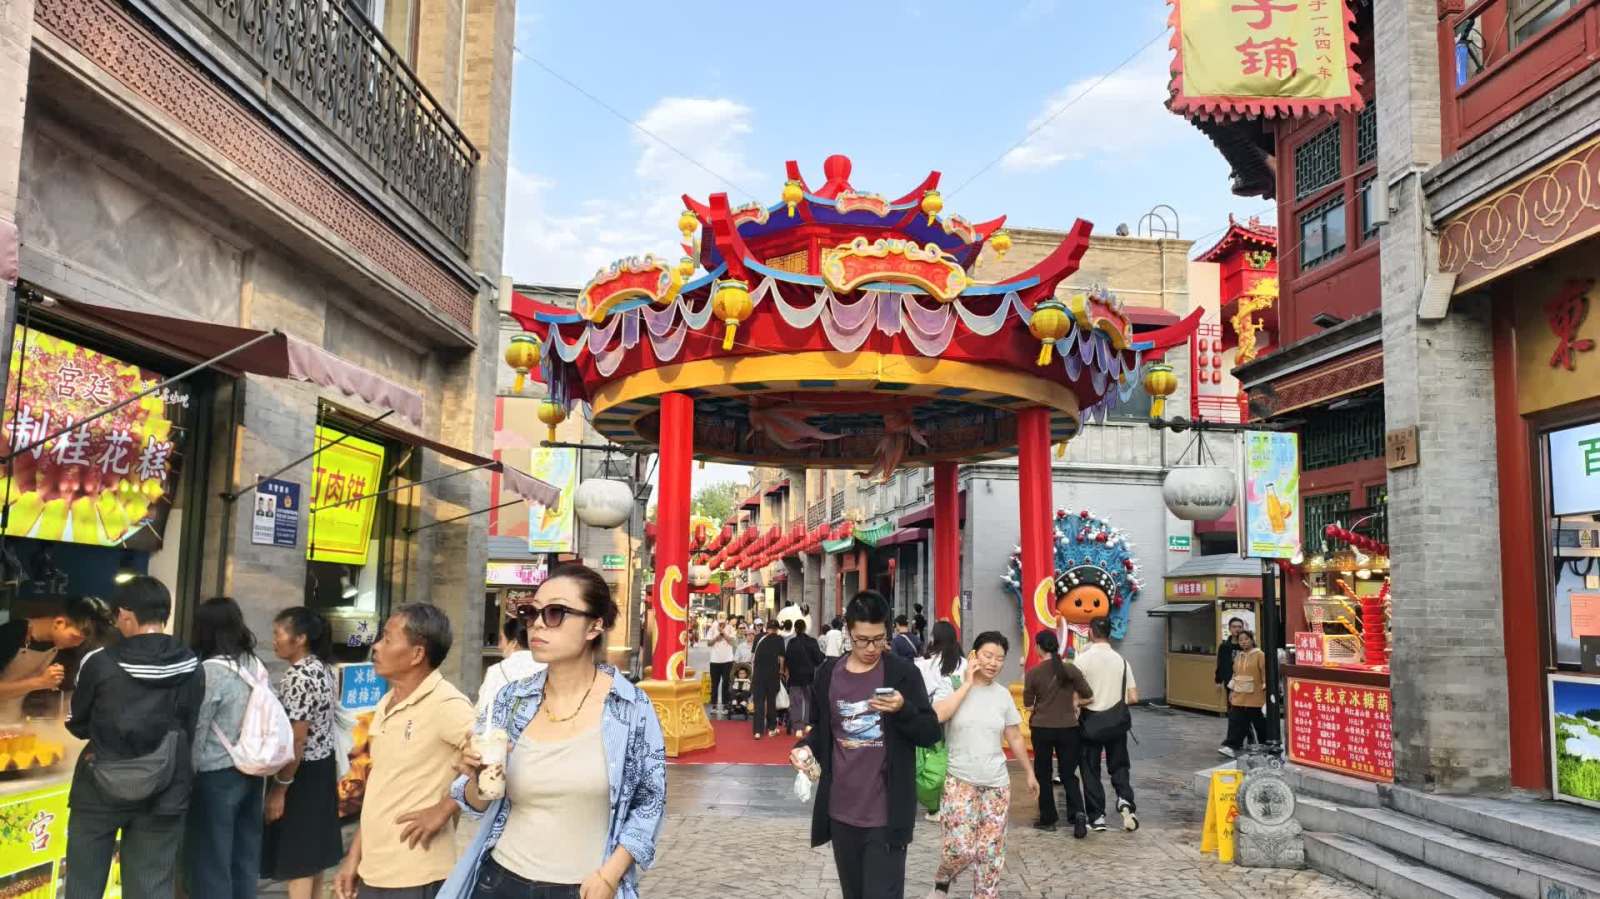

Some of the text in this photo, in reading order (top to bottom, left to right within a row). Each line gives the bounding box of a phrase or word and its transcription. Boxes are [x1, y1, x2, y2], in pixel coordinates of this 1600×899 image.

[58, 362, 113, 406] 宫廷
[6, 404, 174, 481] 制桂花糕
[1313, 687, 1389, 712] 老北京冰糖葫
